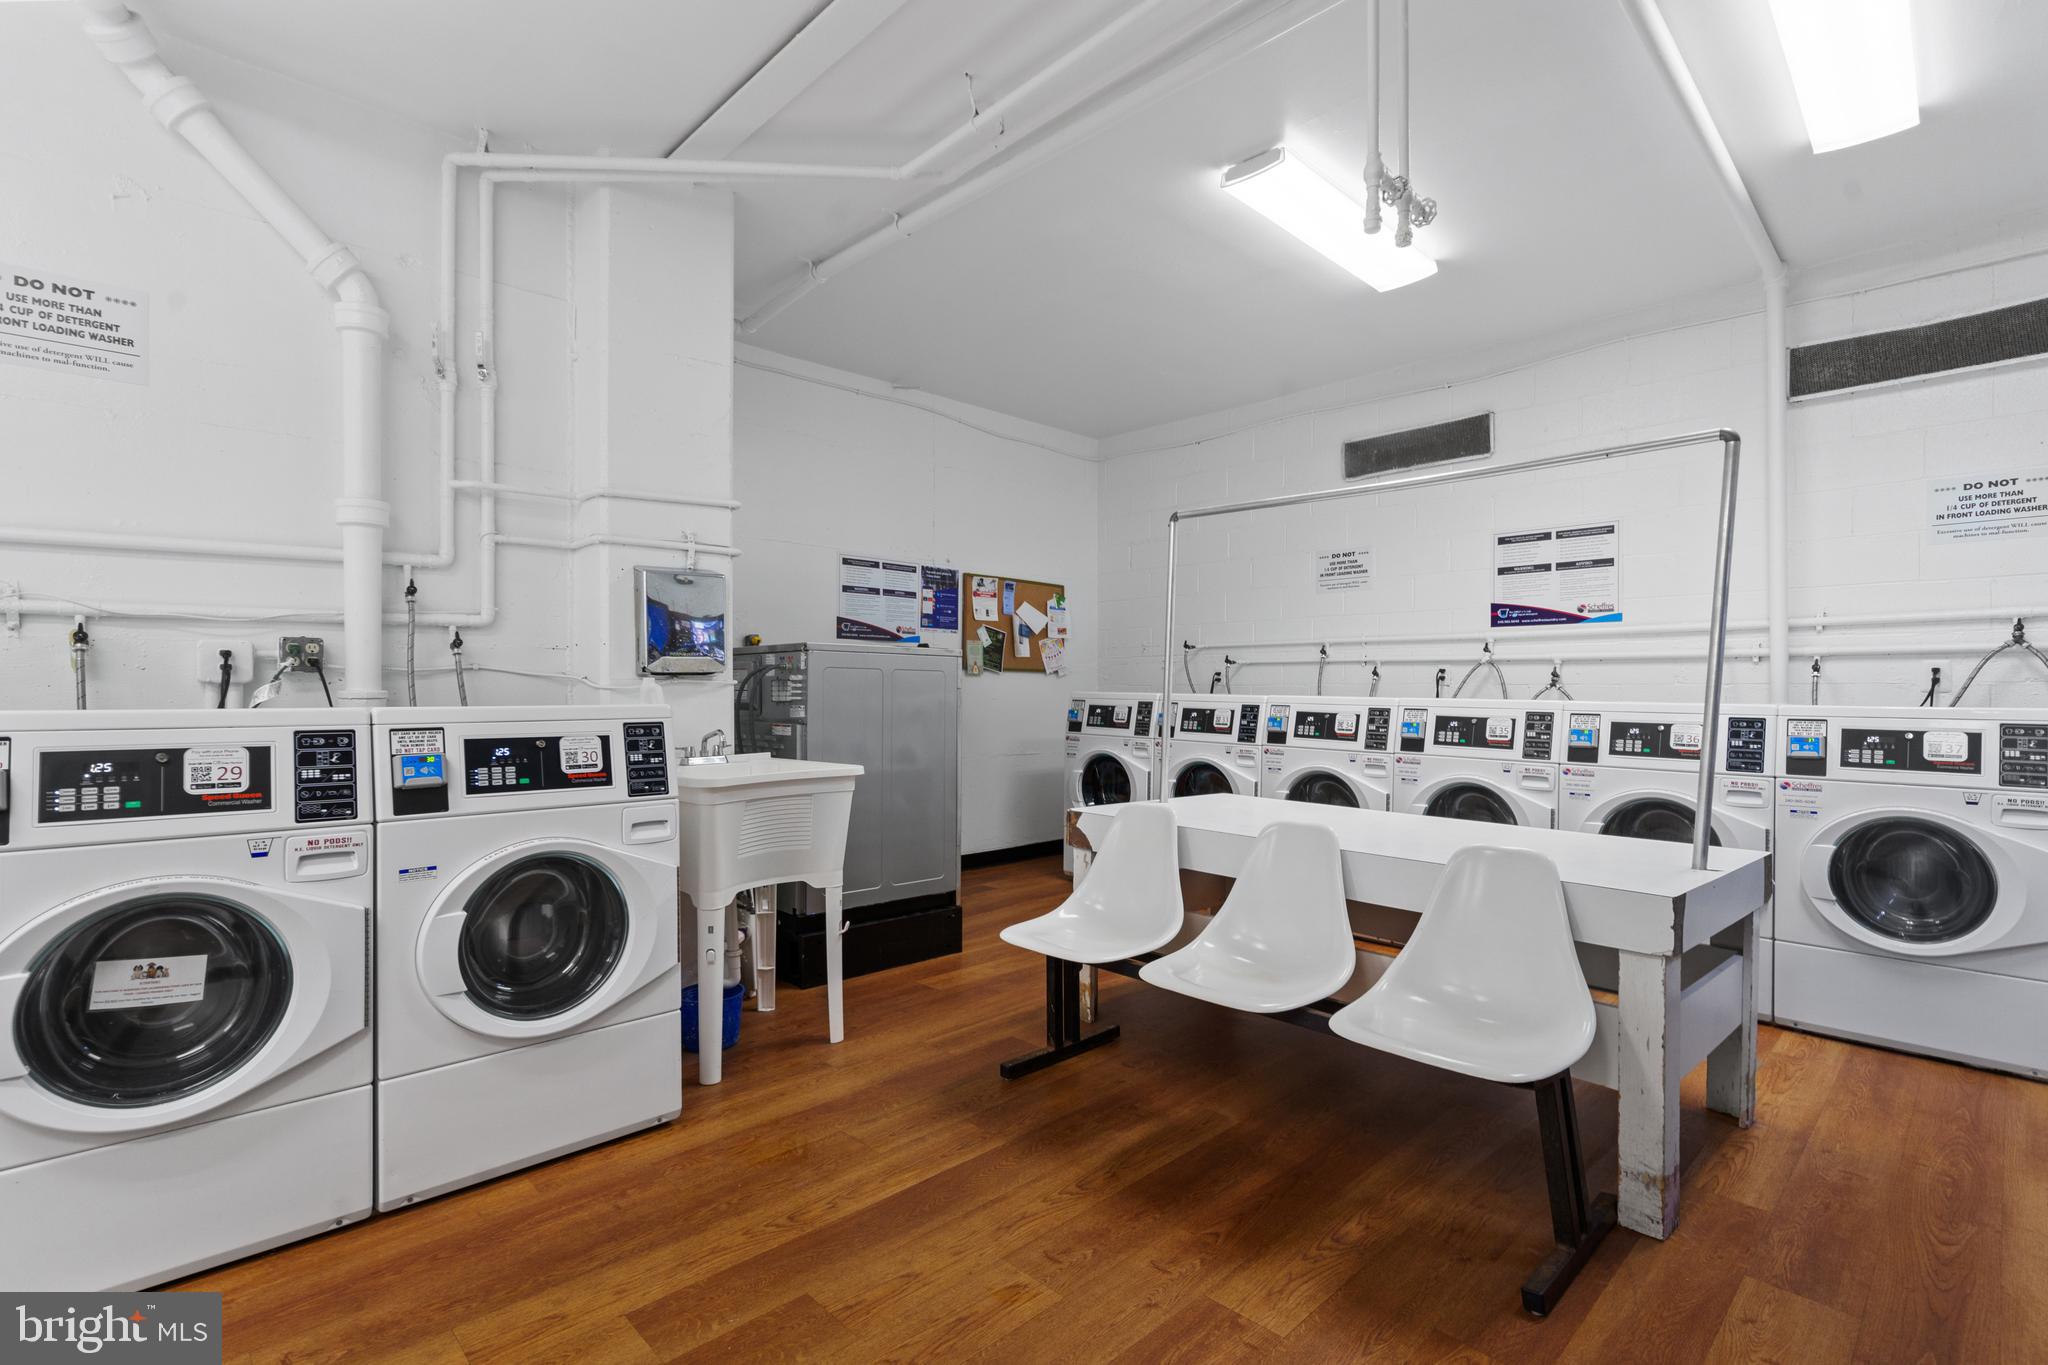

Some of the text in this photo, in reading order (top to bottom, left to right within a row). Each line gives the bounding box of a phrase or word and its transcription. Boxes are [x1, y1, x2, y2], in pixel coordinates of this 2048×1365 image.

[14, 276, 95, 300] DO NOT
[6, 292, 102, 317] USE MORE THAN
[10, 305, 34, 317] CUP
[38, 310, 52, 320] OF
[56, 314, 120, 332] DETERGENT
[32, 322, 86, 339] LOADING
[88, 332, 134, 348] WASHER
[43, 347, 82, 360] detergent
[85, 354, 110, 364] WILL
[54, 358, 110, 372] mal-function.
[1964, 478, 2019, 490] DO NOT
[1974, 492, 1997, 500] MORE
[2000, 490, 2024, 498] THAN
[1978, 500, 1989, 508] OF
[1992, 496, 2037, 506] DETERGENT
[1976, 508, 2011, 516] LOADING
[2014, 504, 2048, 512] WASHER
[1688, 735, 1700, 743] 36
[1945, 744, 1964, 754] 37
[582, 751, 598, 762] 30
[217, 766, 242, 781] 29
